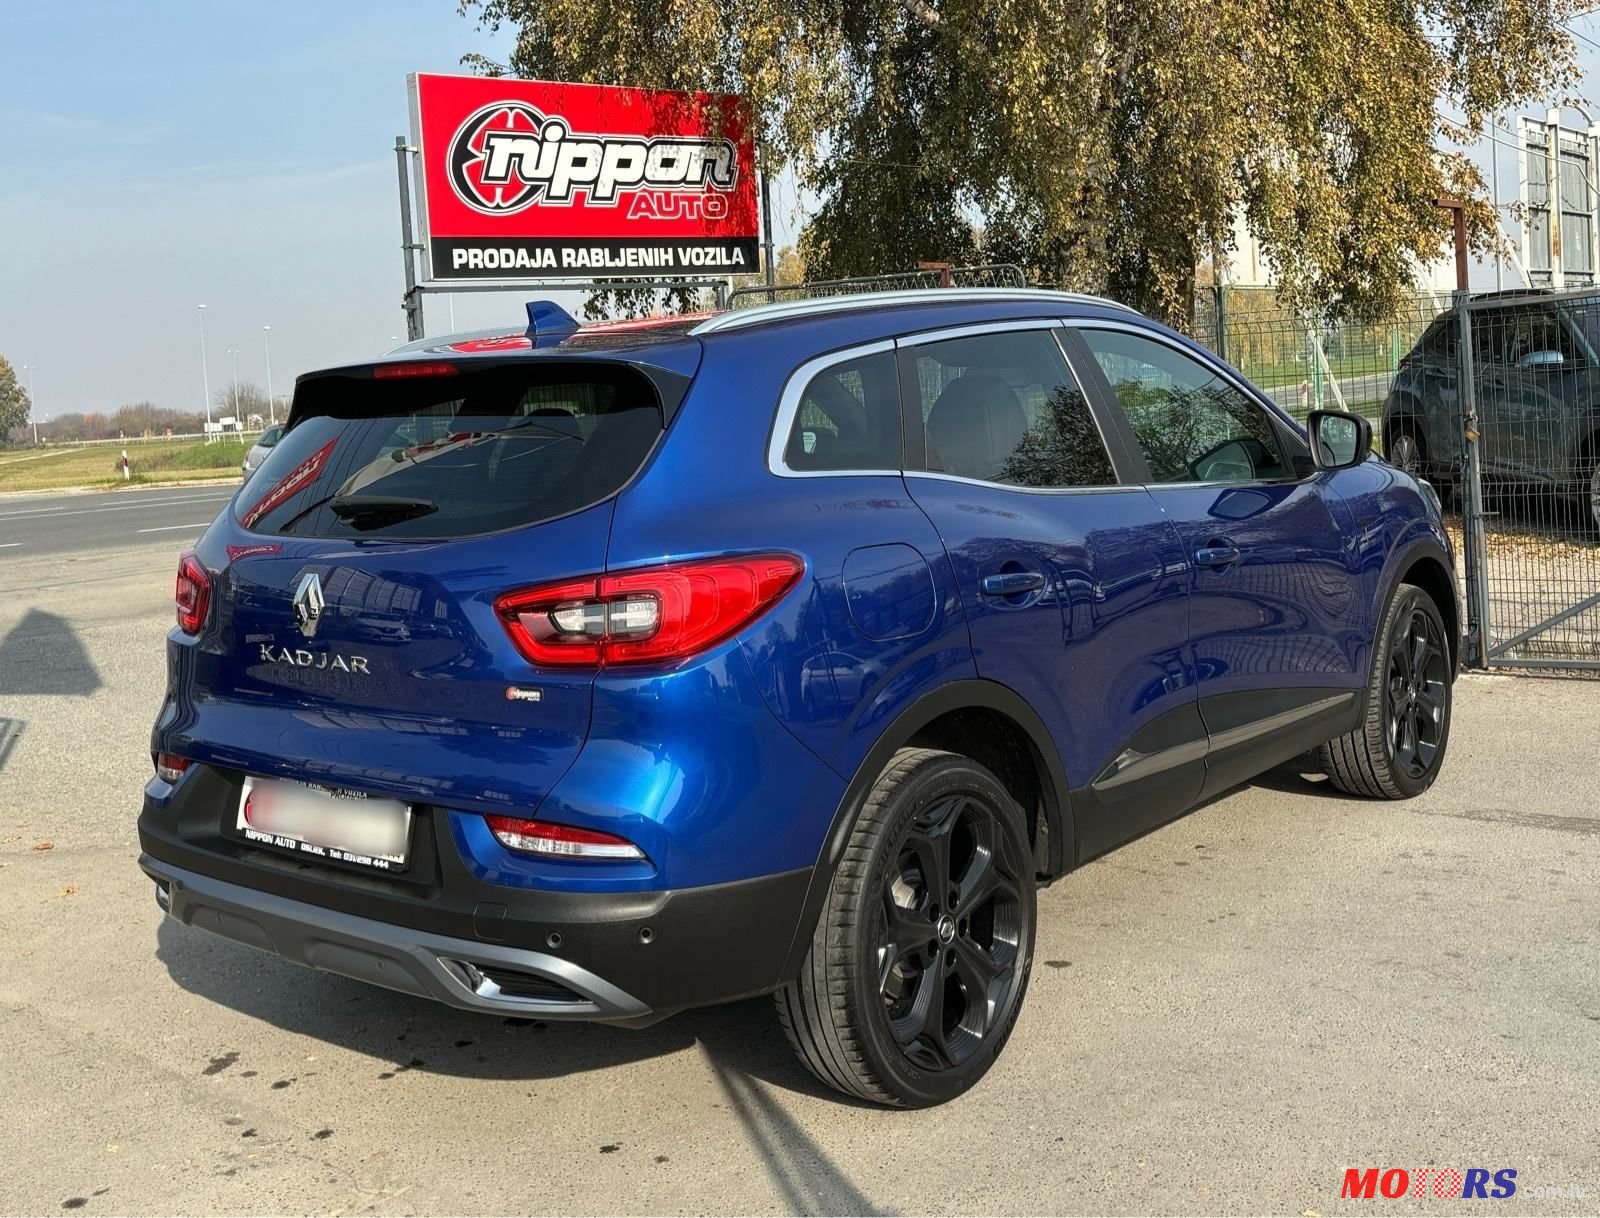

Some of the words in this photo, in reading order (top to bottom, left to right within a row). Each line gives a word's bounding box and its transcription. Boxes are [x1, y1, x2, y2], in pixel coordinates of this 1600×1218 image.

[484, 118, 735, 205] nippon
[627, 193, 729, 220] AUTO
[453, 248, 557, 270] PRODAJA
[563, 247, 674, 268] RABLJENIH
[680, 246, 745, 266] VOZILA
[259, 643, 371, 675] KADJAR
[245, 829, 273, 844] NIPPON
[275, 836, 296, 849] AUTO
[373, 859, 390, 870] 444
